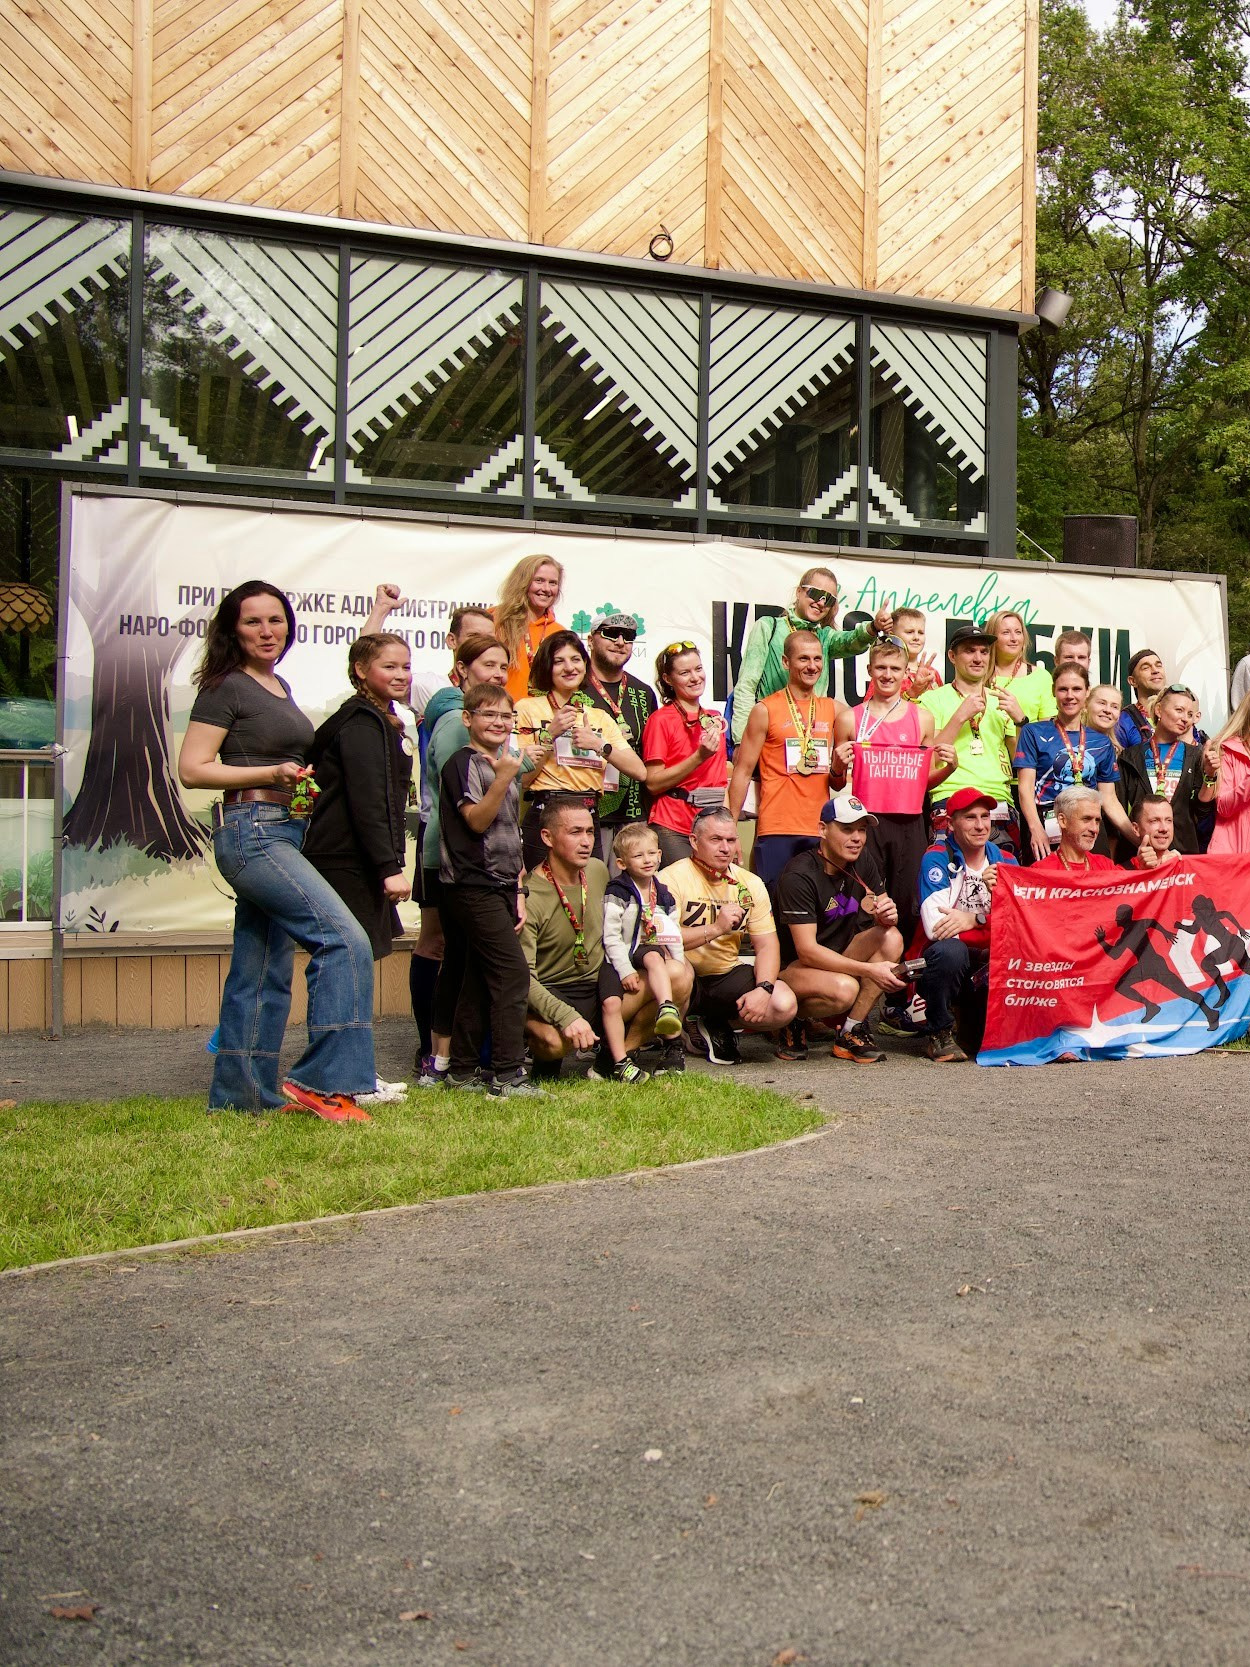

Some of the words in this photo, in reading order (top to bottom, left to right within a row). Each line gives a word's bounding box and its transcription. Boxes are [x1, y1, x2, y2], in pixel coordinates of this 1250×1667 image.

[179, 585, 214, 606] ПРИ
[862, 750, 925, 767] ПЫЛЬНЫЕ
[869, 765, 918, 780] ГАНТЕЛИ
[1008, 958, 1021, 970] И
[1006, 976, 1085, 990] становятся
[1004, 993, 1058, 1008] ближе
